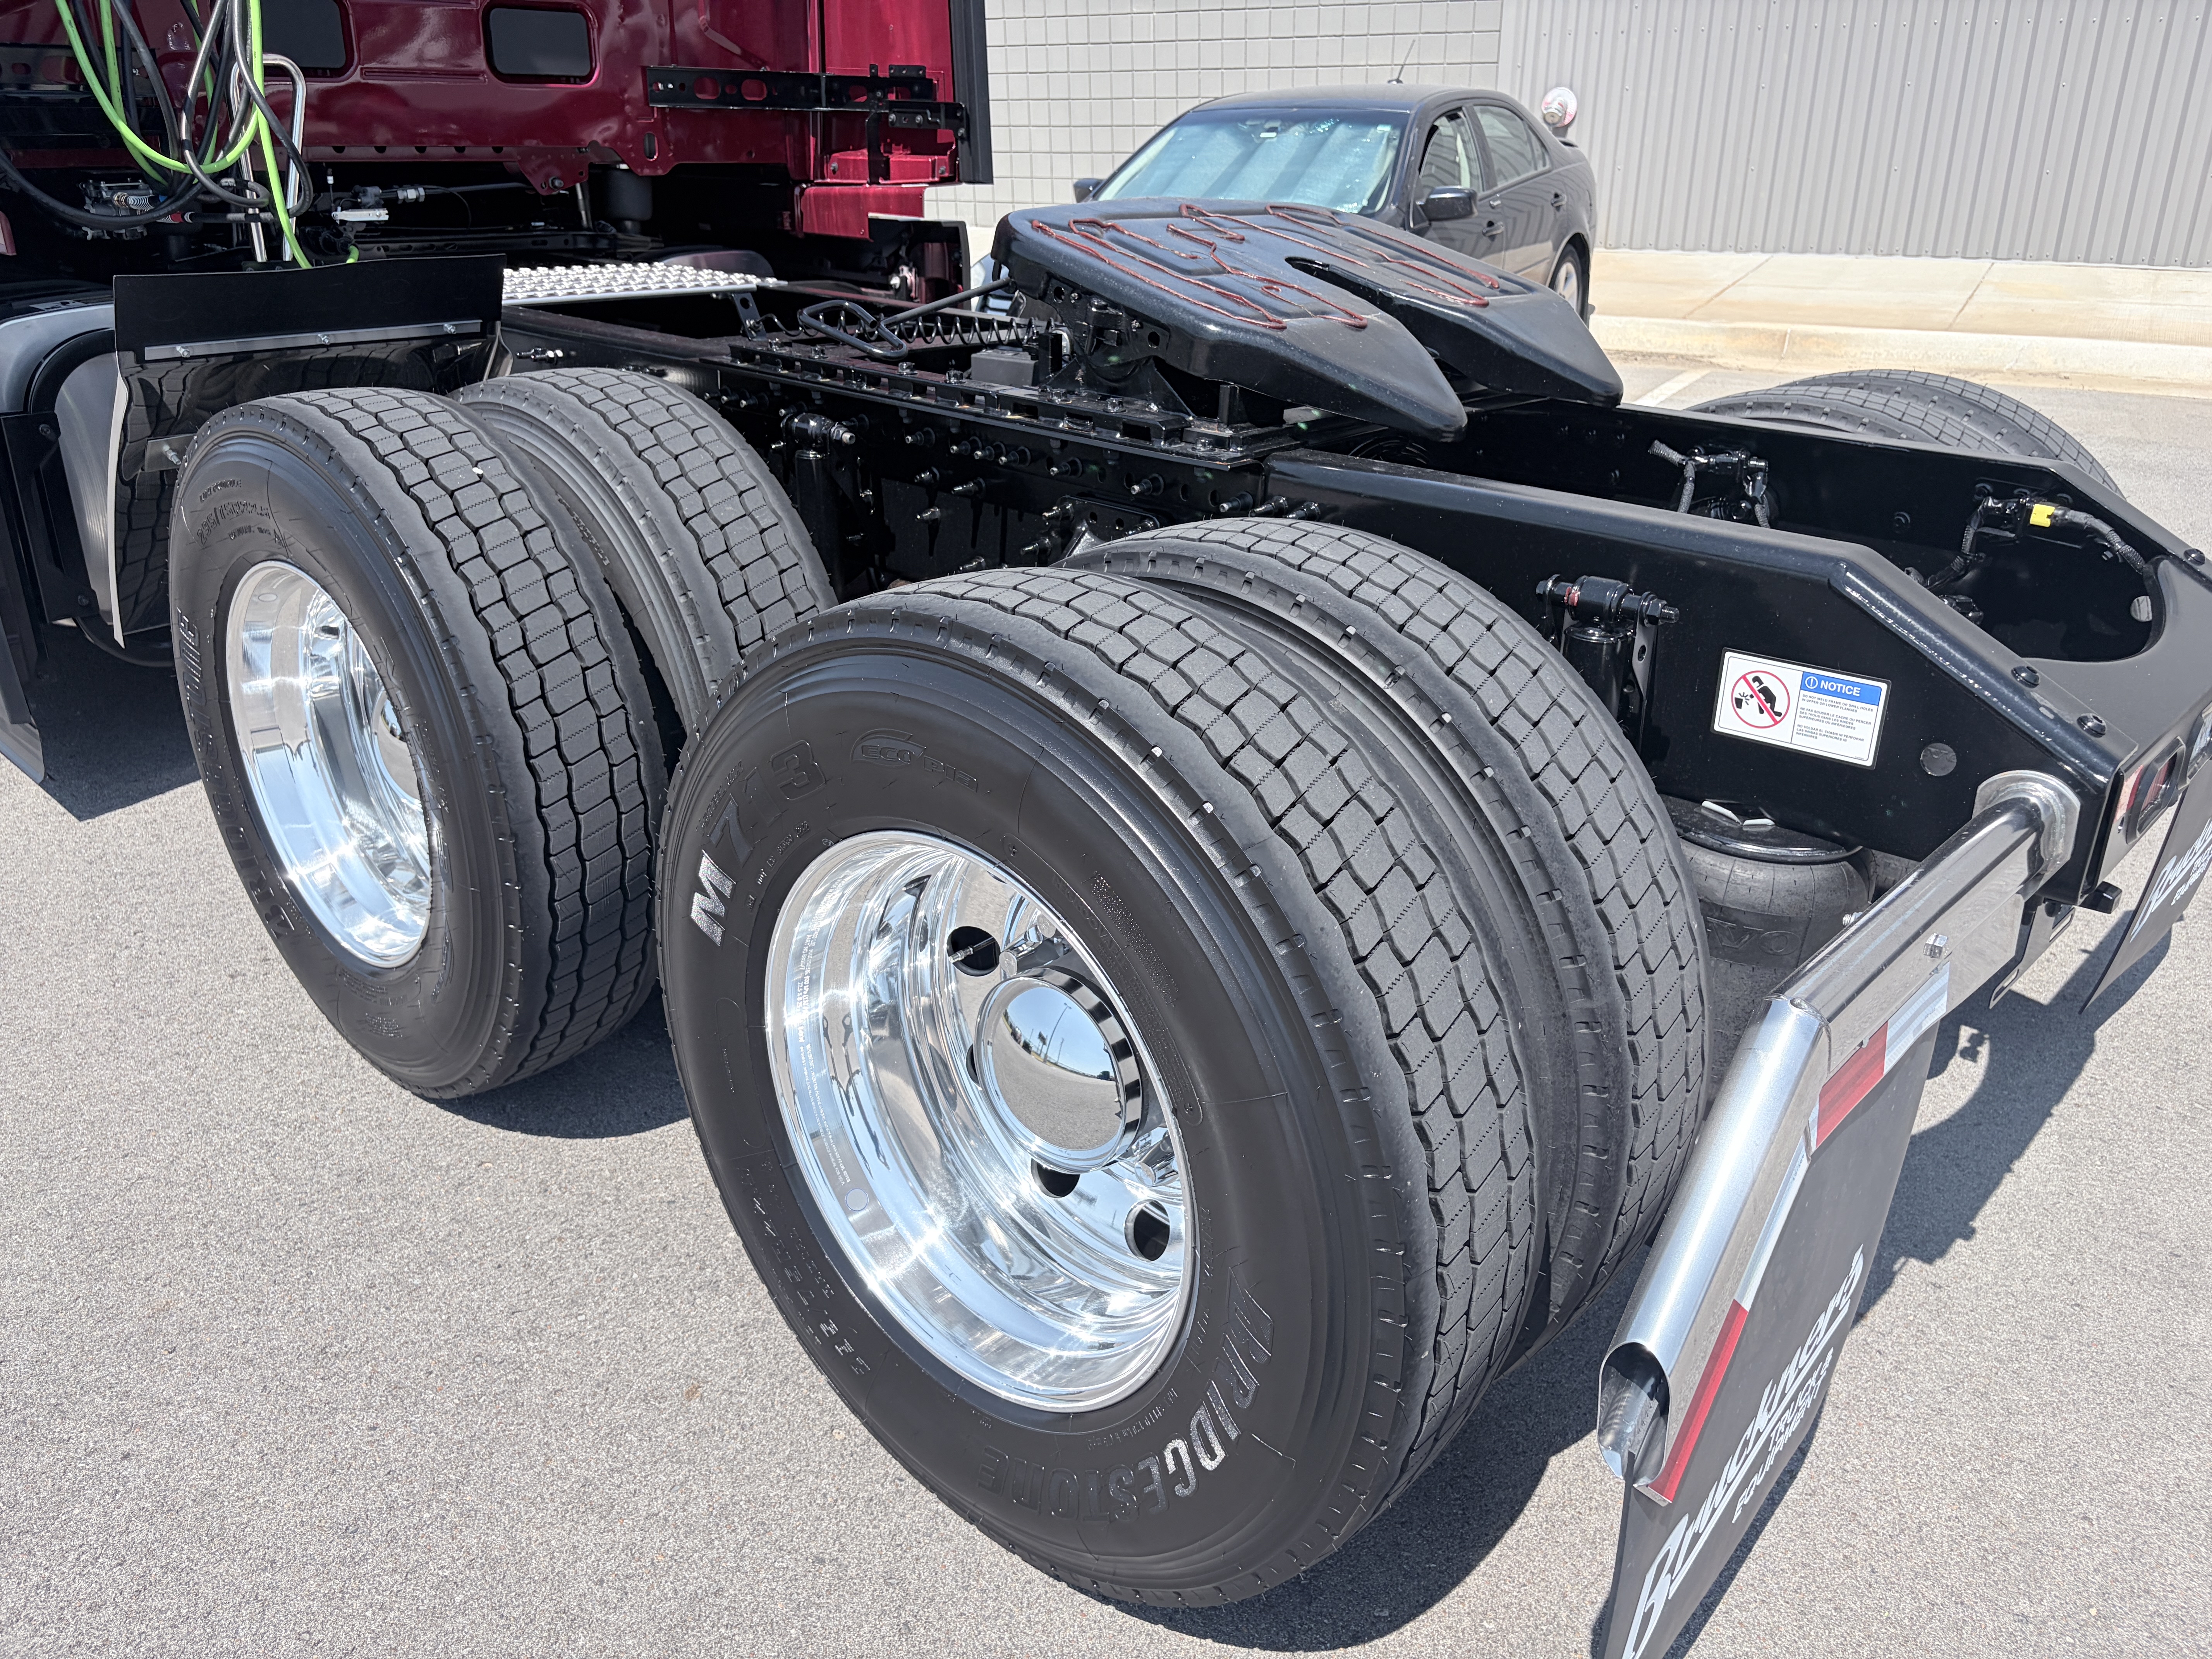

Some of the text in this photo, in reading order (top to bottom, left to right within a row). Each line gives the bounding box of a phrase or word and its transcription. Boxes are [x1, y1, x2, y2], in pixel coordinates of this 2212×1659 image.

[176, 605, 296, 940] BRIDGESTONE
[1820, 678, 1861, 697] NOTICE
[690, 739, 827, 946] M713
[977, 1268, 1276, 1525] BRIDGESTONE
[1732, 1370, 1827, 1523] EQUIPMENT
[1770, 1361, 1822, 1452] TRUCK
